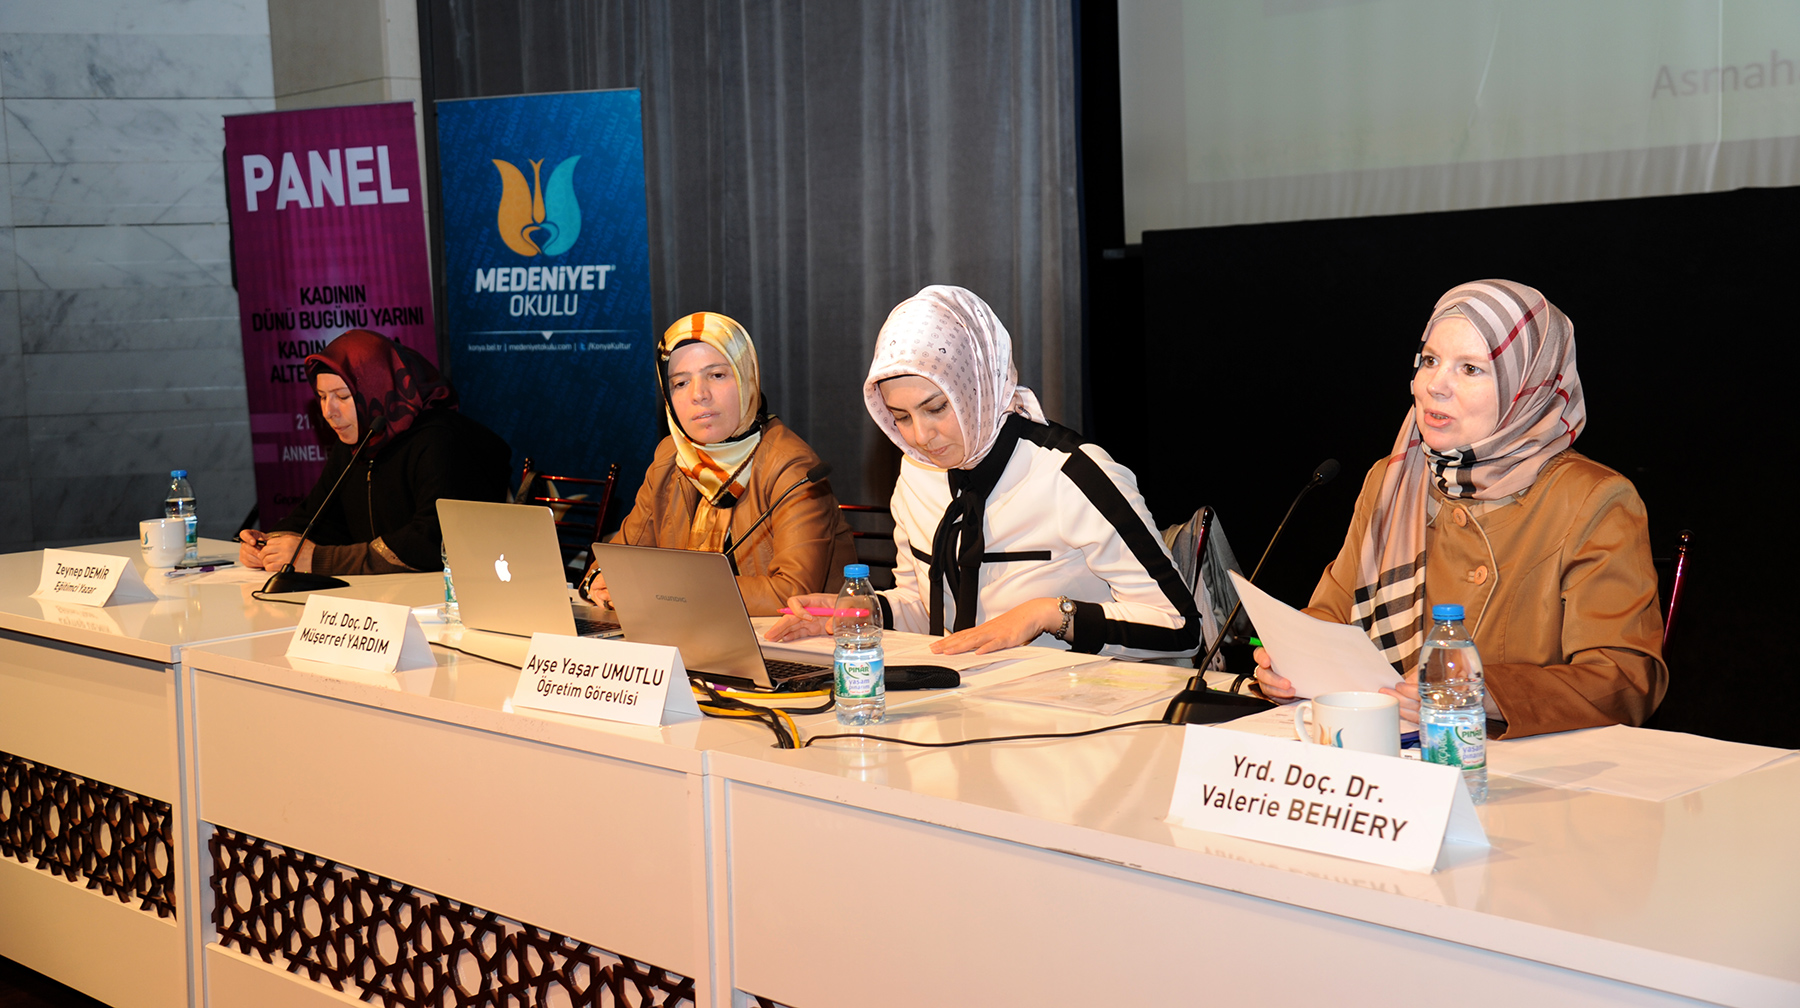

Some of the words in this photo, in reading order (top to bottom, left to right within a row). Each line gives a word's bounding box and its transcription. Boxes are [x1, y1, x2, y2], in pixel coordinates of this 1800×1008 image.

[1651, 48, 1800, 100] Asmah
[242, 145, 410, 212] PANEL
[300, 285, 367, 306] KADININ
[509, 293, 579, 317] OKULU
[252, 308, 296, 332] DÜNÜ
[300, 304, 369, 329] BUGÜNÜ
[371, 306, 425, 327] YARINI
[468, 343, 502, 352] konya.bel.tr
[509, 343, 573, 352] medeniyetokulu.com
[270, 364, 308, 383] ALTE
[55, 562, 84, 579] Zeynep
[84, 564, 110, 580] DEMİR
[53, 580, 79, 594] Eğitimci
[78, 583, 97, 595] Yazar
[655, 594, 687, 603] GRUNDIG
[320, 610, 338, 627] Yrd.
[340, 613, 361, 631] Doç.
[363, 616, 379, 632] Dr.
[299, 627, 347, 648] Müşerref
[346, 634, 390, 655] YARDIM
[526, 654, 558, 676] Ayşe
[561, 657, 600, 679] Yaşar
[601, 662, 664, 687] UMUTLU
[536, 675, 582, 698] Öğretim
[584, 684, 639, 706] Görevlisi
[1233, 755, 1275, 782] Yrd.
[1284, 764, 1336, 795] Doç.
[1346, 775, 1384, 803] Dr.
[1202, 784, 1280, 818] Valerie
[1287, 798, 1408, 842] BEHİERY
